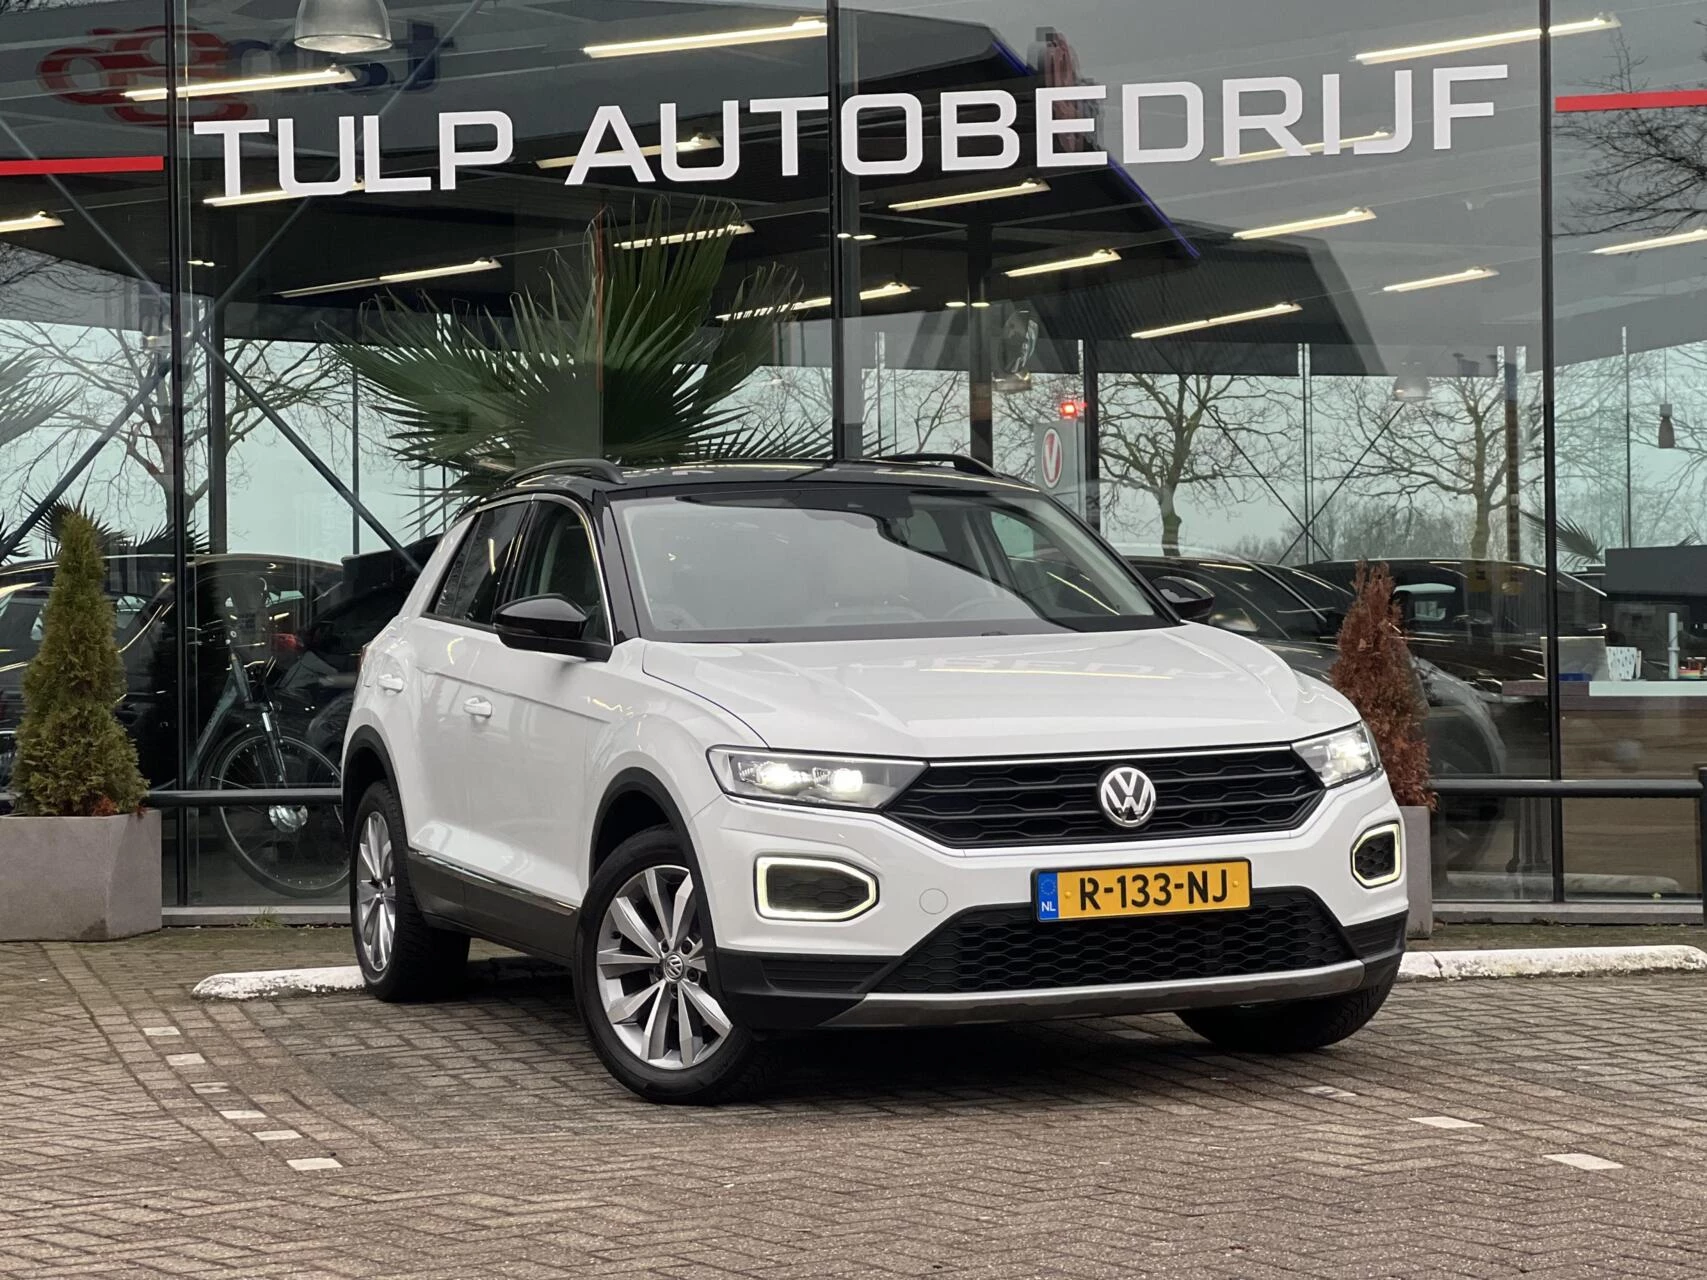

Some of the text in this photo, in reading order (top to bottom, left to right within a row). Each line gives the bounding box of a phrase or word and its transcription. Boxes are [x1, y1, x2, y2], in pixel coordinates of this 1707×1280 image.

[193, 65, 1508, 197] TULP AUTOBEDRIJF
[1041, 869, 1228, 912] NL R-133-NJ
